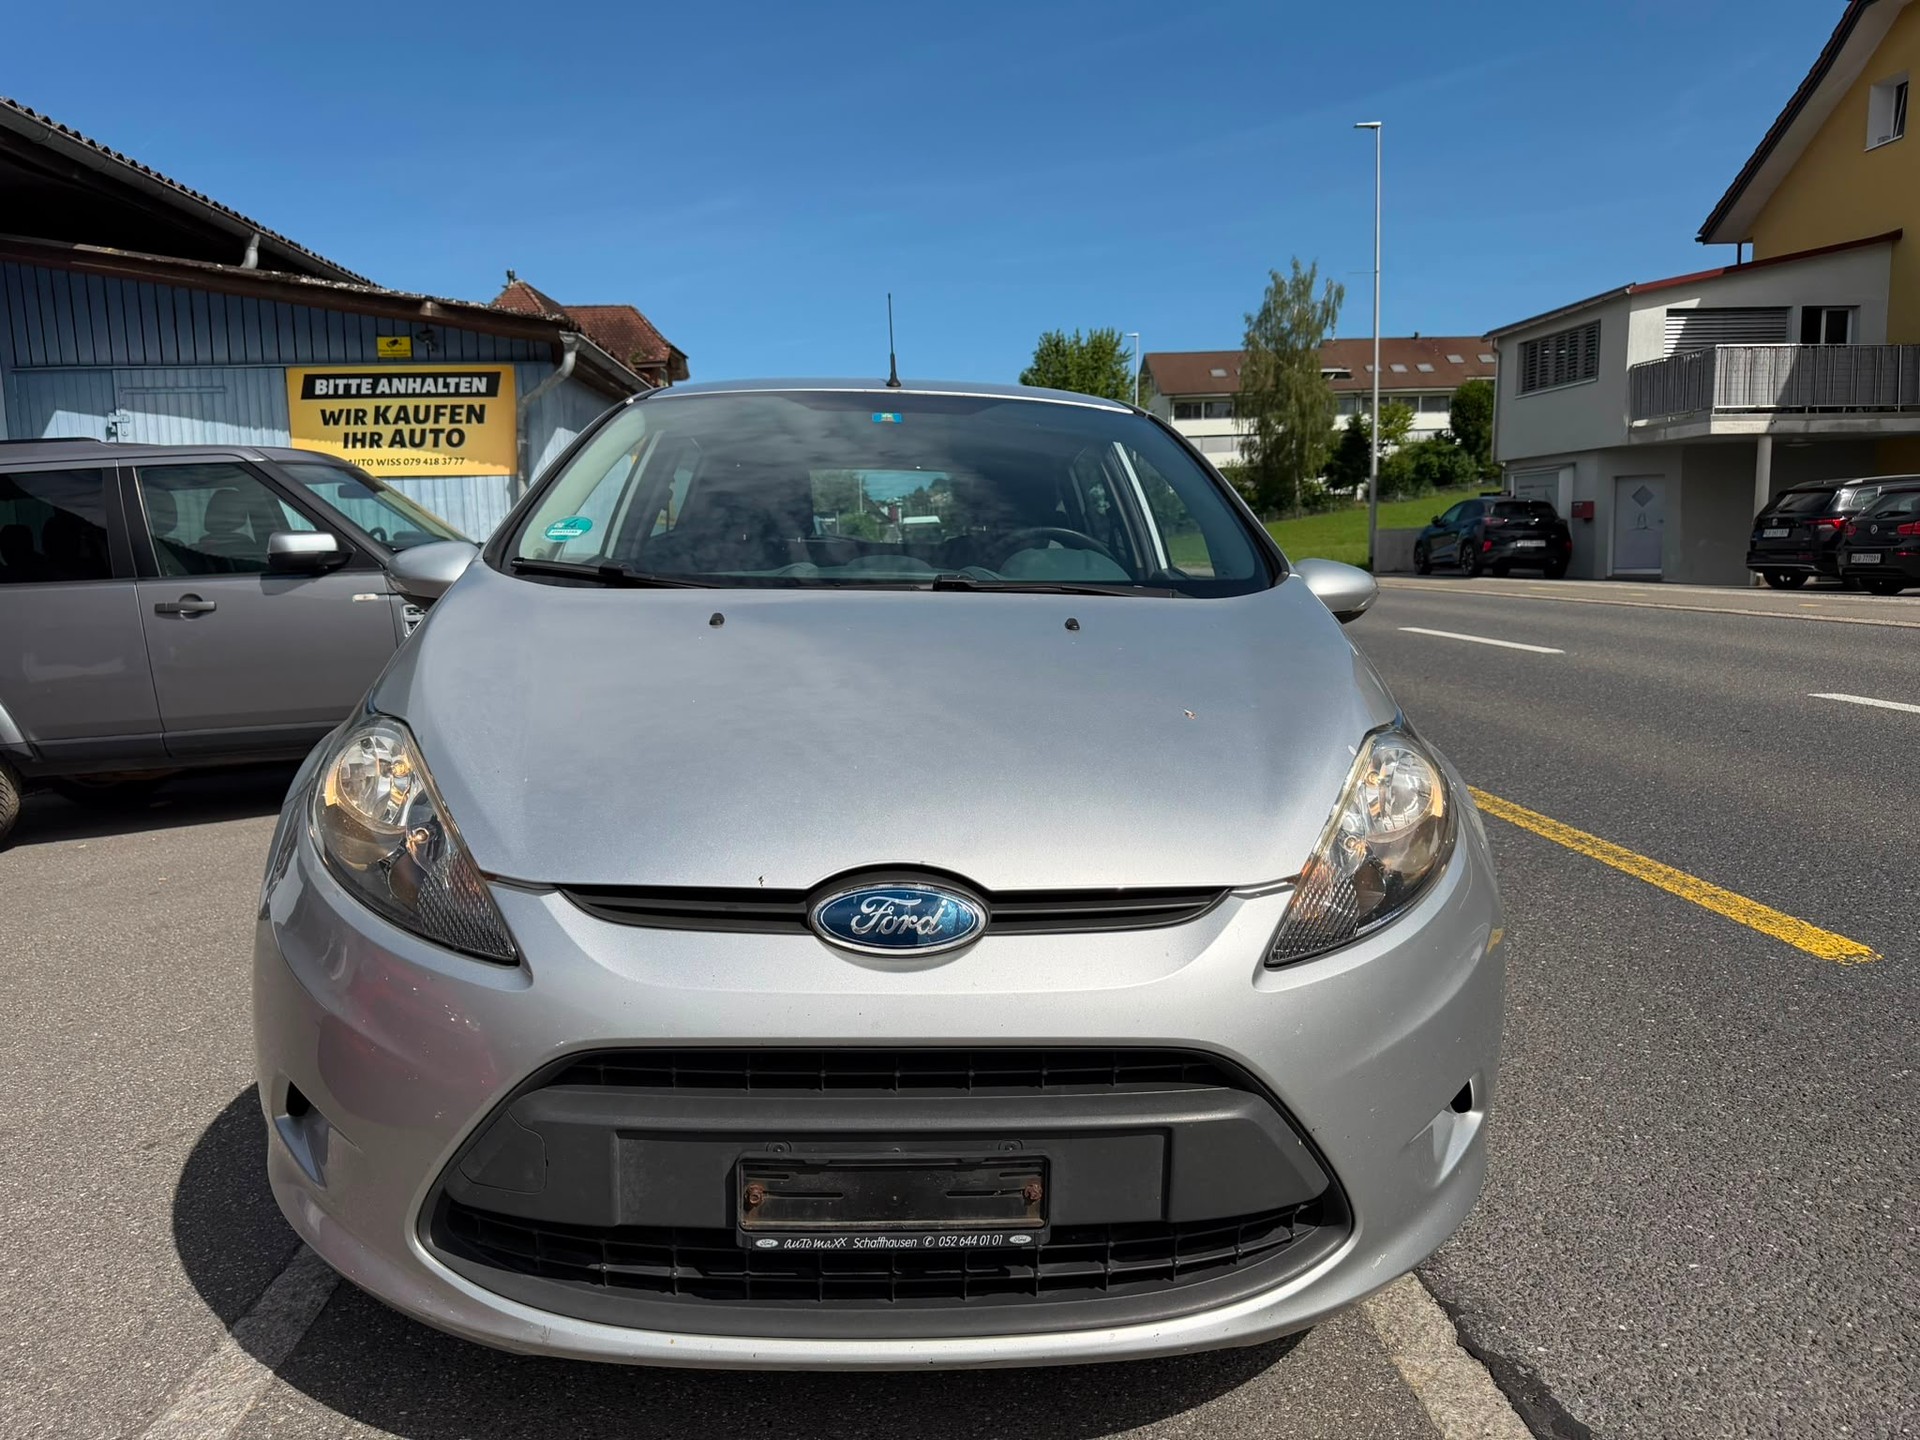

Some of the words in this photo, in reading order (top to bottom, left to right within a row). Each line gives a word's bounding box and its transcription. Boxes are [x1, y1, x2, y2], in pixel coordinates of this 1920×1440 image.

[314, 377, 373, 396] BITTE
[375, 376, 487, 394] ANHALTEN
[320, 408, 367, 426] WIR
[373, 404, 486, 425] KAUFEN
[343, 431, 382, 449] IHR
[388, 428, 466, 448] AUTO
[375, 458, 401, 467] WISS
[403, 457, 421, 466] 079
[422, 457, 440, 466] 418
[851, 896, 947, 935] Ford
[853, 1236, 918, 1248] Schaffhausen
[938, 1235, 958, 1247] 052
[959, 1235, 978, 1247] 644
[980, 1234, 990, 1246] 01
[992, 1234, 1003, 1246] 01
